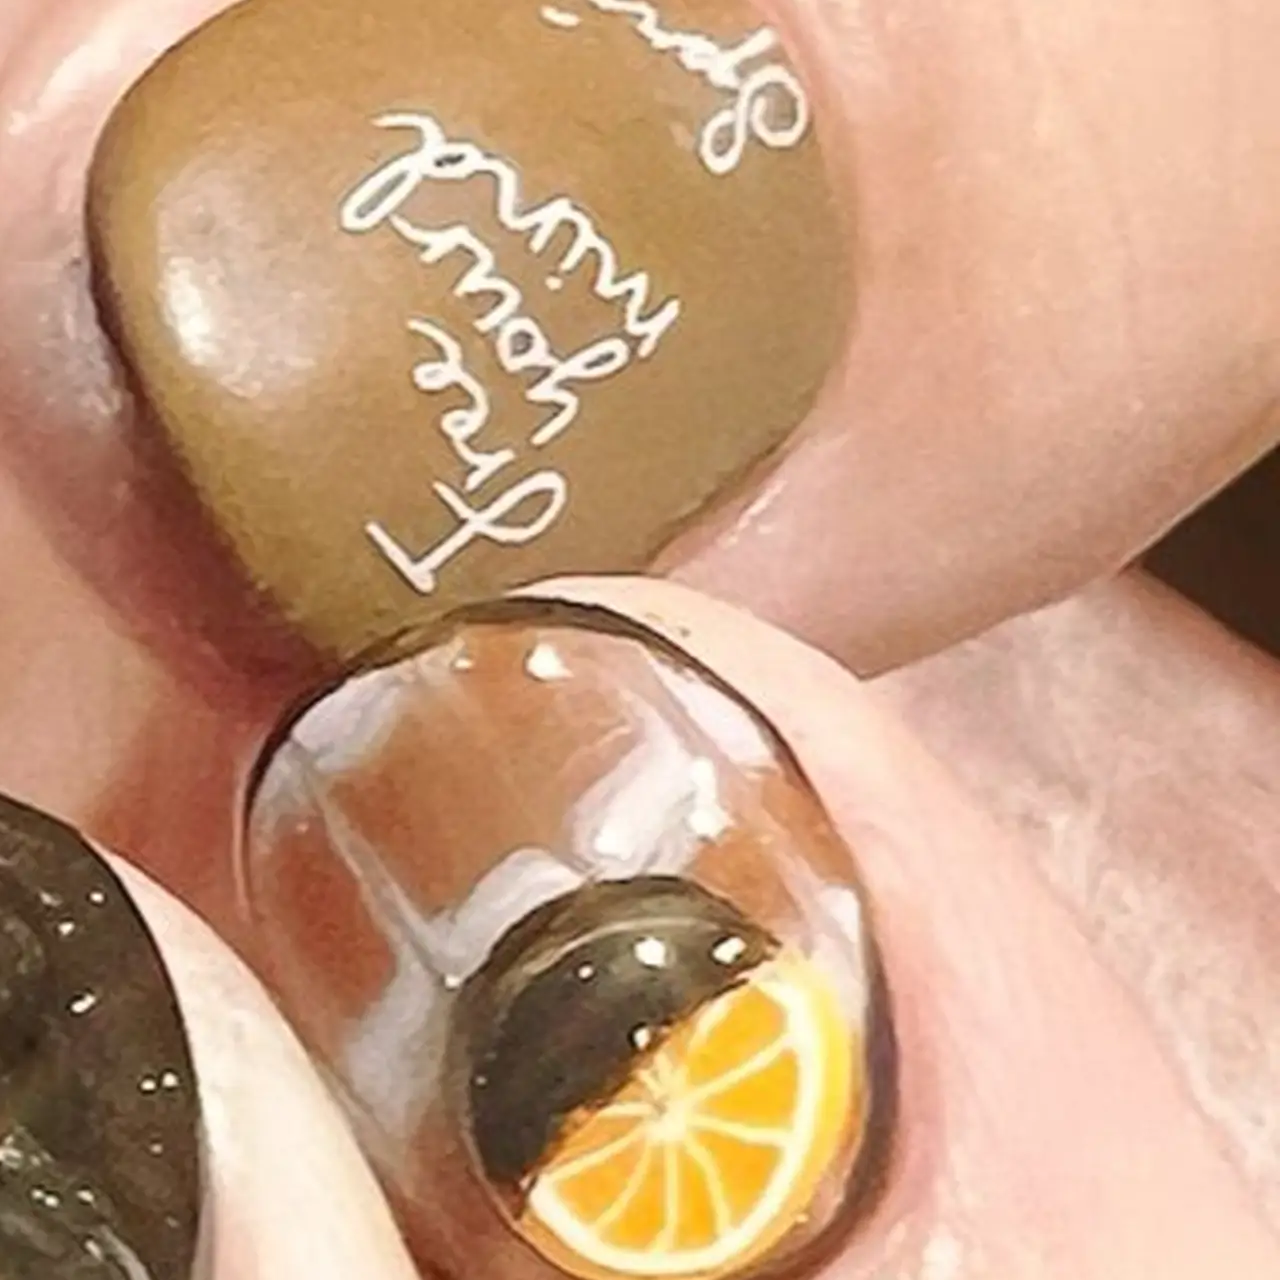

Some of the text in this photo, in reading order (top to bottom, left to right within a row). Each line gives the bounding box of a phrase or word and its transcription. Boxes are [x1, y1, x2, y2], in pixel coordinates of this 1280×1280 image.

[340, 112, 680, 358] mind
[390, 212, 629, 445] your
[365, 319, 567, 594] Free
